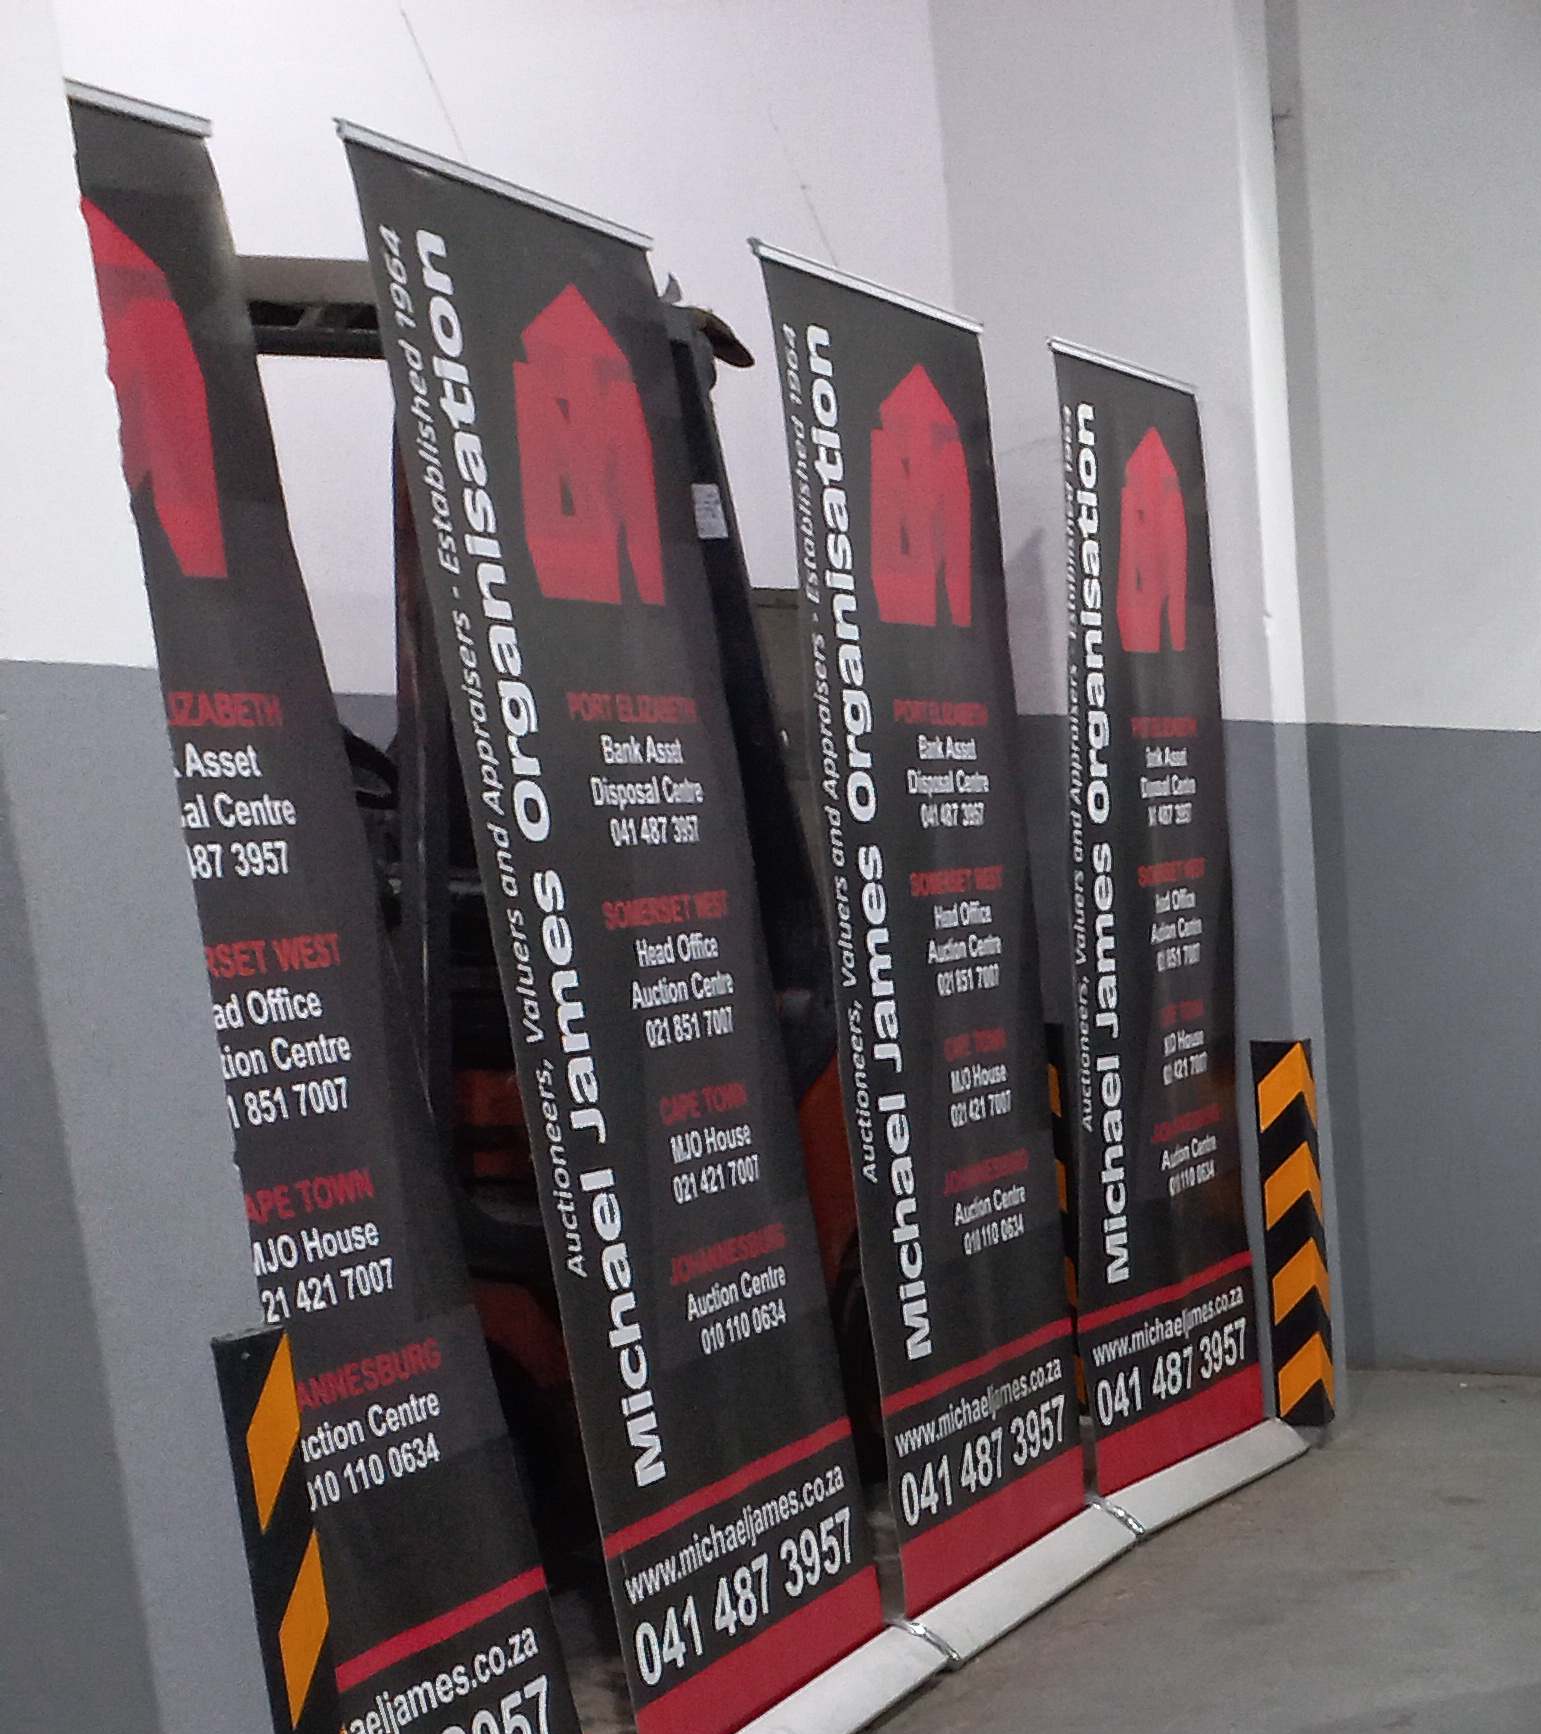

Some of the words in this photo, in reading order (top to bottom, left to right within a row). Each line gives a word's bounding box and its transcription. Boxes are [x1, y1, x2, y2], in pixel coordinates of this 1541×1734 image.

[378, 223, 416, 329] 1964
[398, 338, 461, 575] Established
[416, 229, 551, 842] Organisation
[806, 324, 877, 822] Organisation
[1077, 403, 1110, 824] Organisation
[452, 609, 505, 816] Appraisers
[811, 632, 841, 800] Appraisers
[184, 742, 262, 778] Asset
[600, 733, 644, 765] Bank
[646, 735, 684, 765] Asset
[182, 794, 210, 829] al
[213, 792, 296, 828] Centre
[589, 775, 661, 811] Disposal
[661, 775, 704, 804] Centre
[230, 840, 289, 877] 3957
[487, 822, 520, 898] and
[610, 817, 638, 847] 041
[640, 815, 668, 845] 487
[824, 805, 845, 868] and
[1070, 810, 1083, 862] and
[271, 932, 341, 972] WEST
[635, 935, 675, 967] Head
[677, 931, 719, 963] Office
[834, 875, 857, 987] Valuers
[858, 844, 902, 1073] James
[1092, 842, 1119, 1039] James
[246, 987, 323, 1025] Office
[507, 907, 545, 1043] Valuers
[533, 869, 606, 1144] James
[631, 976, 689, 1010] Auction
[690, 970, 734, 1000] Centre
[270, 1034, 352, 1071] Centre
[645, 1016, 670, 1048] 021
[672, 1011, 701, 1043] 851
[703, 1005, 734, 1038] 7007
[243, 1086, 290, 1126] 851
[291, 1076, 348, 1117] 7007
[847, 1000, 878, 1184] Auctioneers,
[535, 1058, 588, 1278] Auctioneers,
[703, 1124, 751, 1155] House
[1096, 1055, 1130, 1284] Michael
[299, 1168, 375, 1213] TOWN
[672, 1172, 698, 1205] 021
[700, 1163, 726, 1194] 421
[727, 1155, 760, 1187] 7007
[300, 1221, 380, 1263] House
[878, 1093, 932, 1360] Michael
[296, 1273, 337, 1312] 421
[340, 1257, 394, 1301] 7007
[686, 1281, 740, 1322] Auction
[740, 1265, 786, 1300] Centre
[579, 1168, 667, 1488] Michael
[701, 1324, 724, 1355] 010
[725, 1314, 750, 1345] 110
[751, 1299, 786, 1335] 0634
[1097, 1365, 1143, 1426] 041
[1152, 1346, 1193, 1400] 487
[1200, 1317, 1247, 1379] 3957
[368, 1392, 440, 1439] Centre
[344, 1454, 386, 1495] 110
[388, 1432, 441, 1479] 0634
[901, 1455, 952, 1526] 041
[960, 1426, 1003, 1493] 487
[1010, 1394, 1065, 1466] 3957
[625, 1465, 845, 1605] www.michaeljames.co.za
[635, 1595, 703, 1686] 041
[713, 1553, 769, 1637] 487
[779, 1506, 851, 1598] 3957
